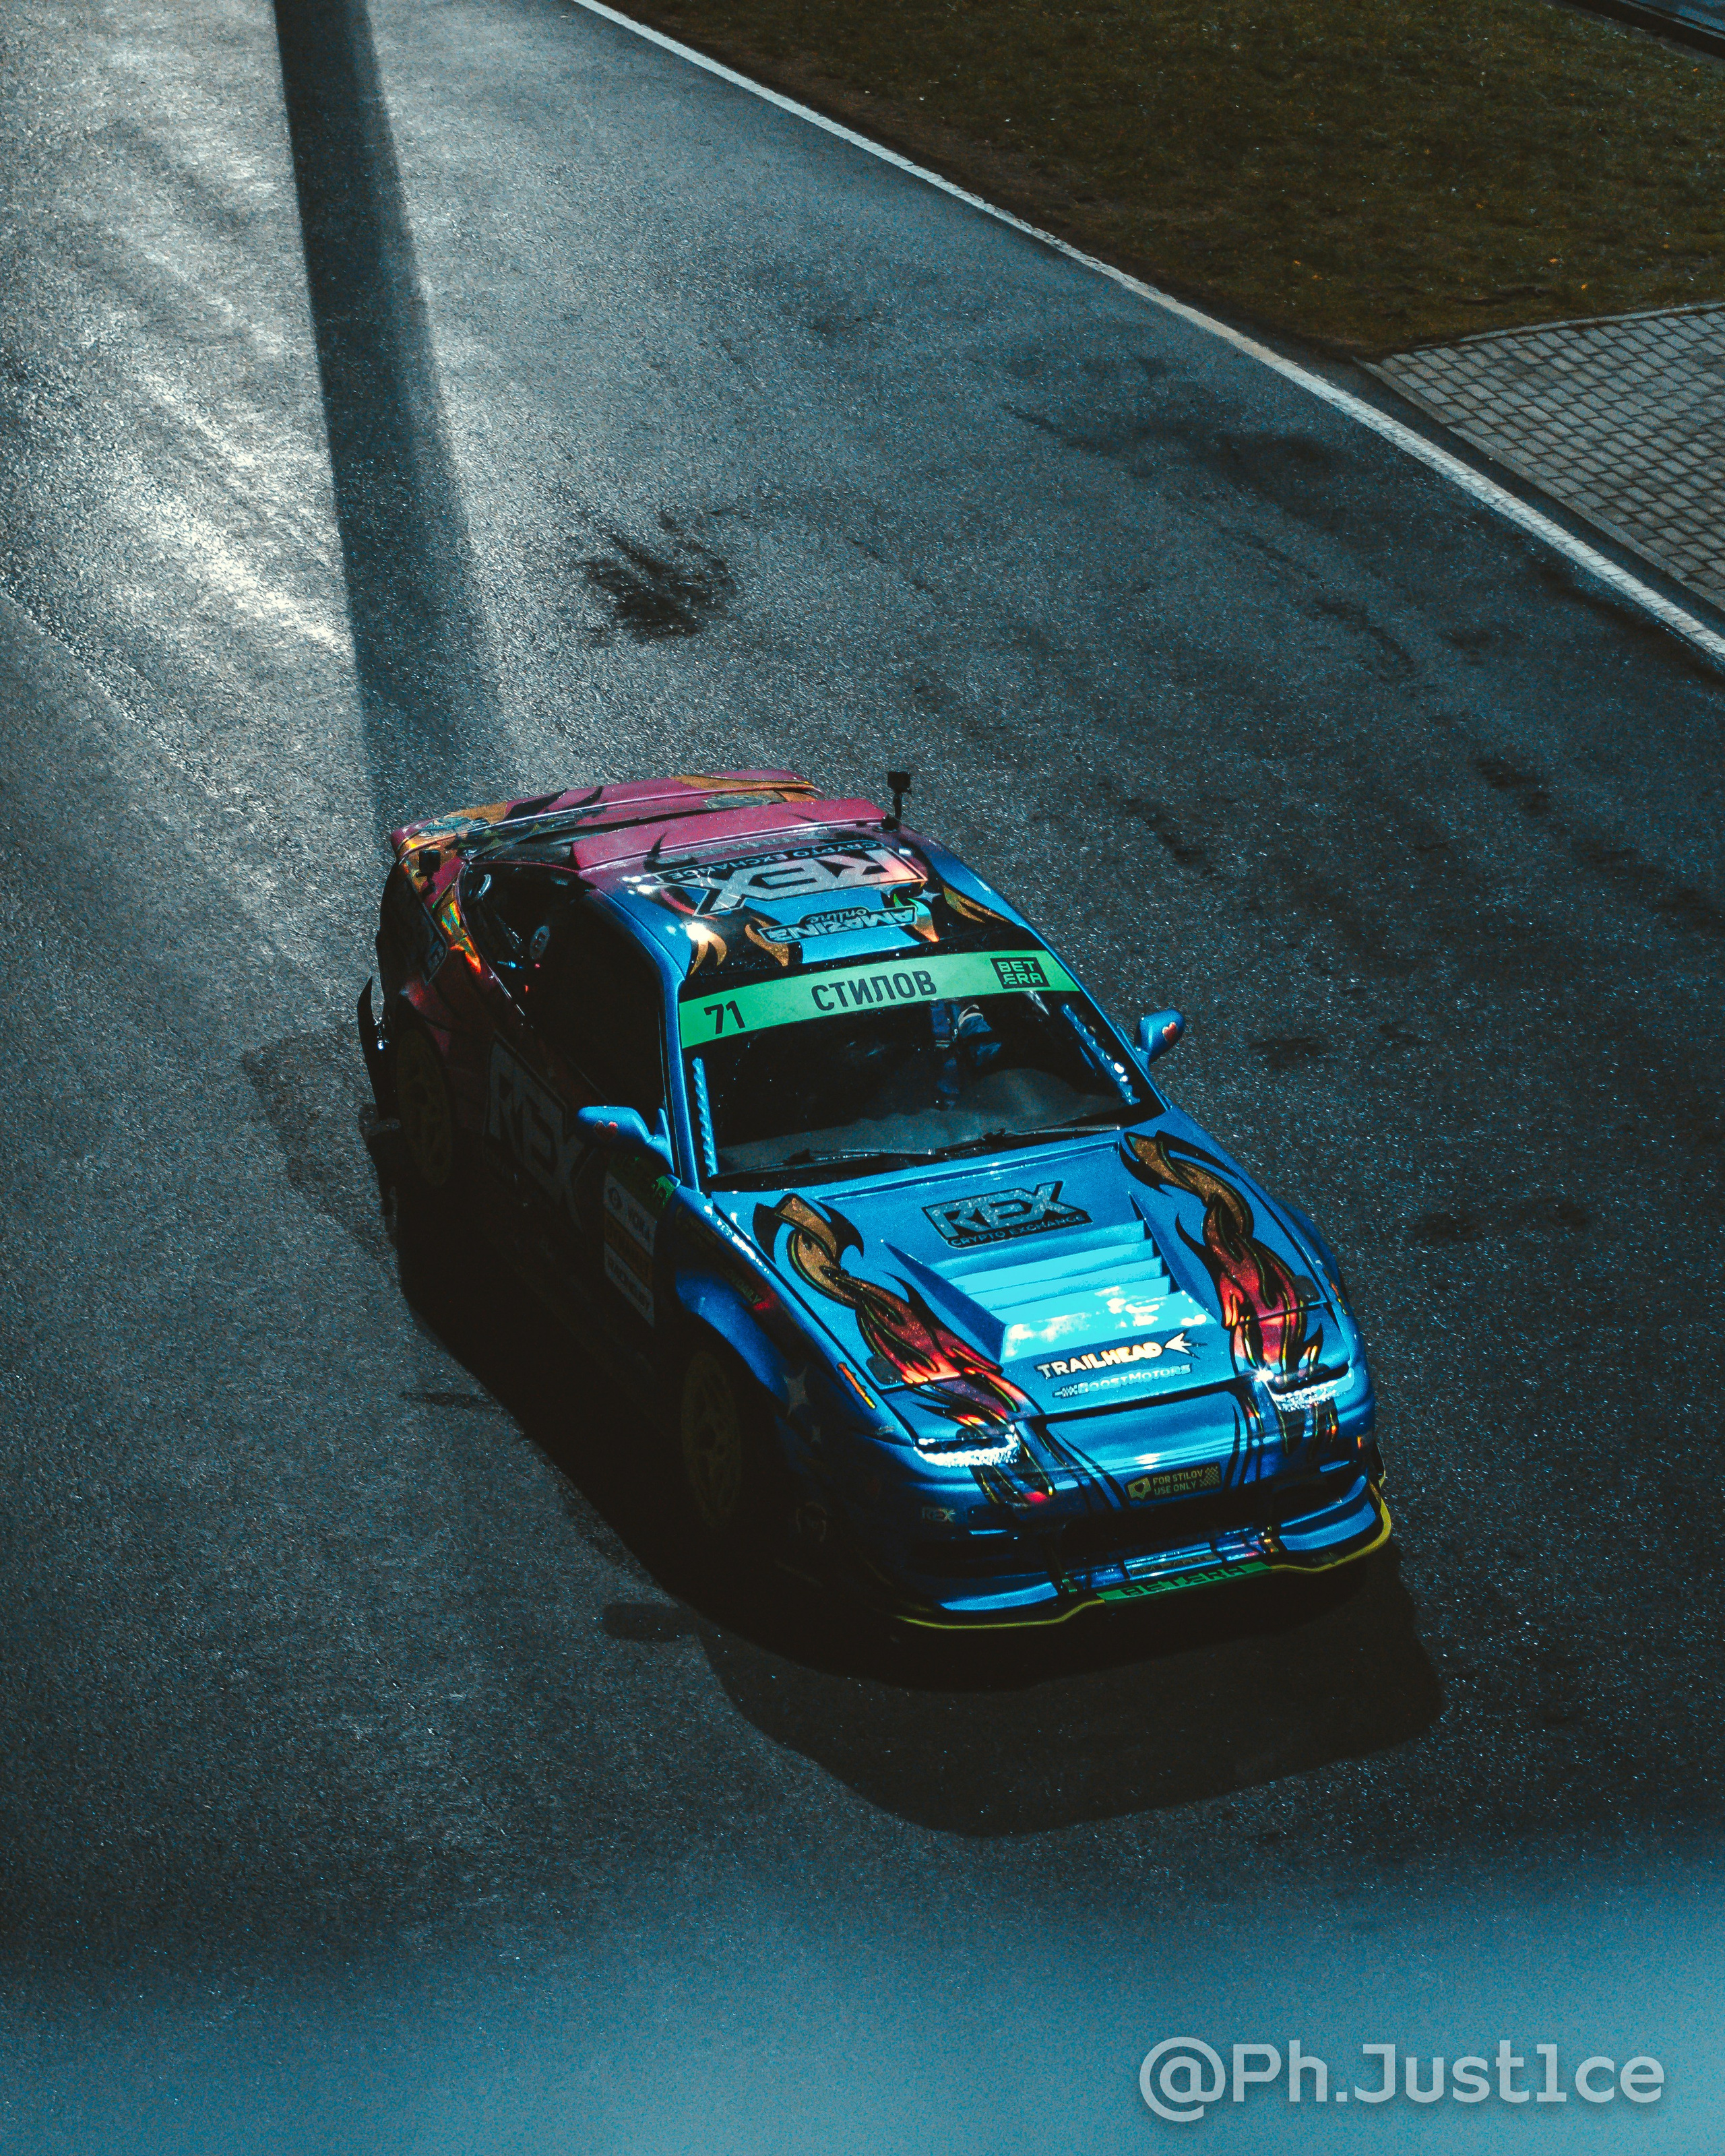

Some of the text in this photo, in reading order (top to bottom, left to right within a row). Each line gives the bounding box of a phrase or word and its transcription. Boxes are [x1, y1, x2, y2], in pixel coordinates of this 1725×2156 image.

[792, 842, 878, 858] CRYPTO
[668, 854, 788, 880] EXCHANGE
[678, 848, 918, 911] REX
[806, 909, 867, 924] online
[997, 961, 1034, 973] BET
[1003, 972, 1044, 985] ERA
[812, 970, 937, 1011] СТИЛОВ
[703, 1001, 745, 1036] 71
[925, 1182, 1079, 1238] REX
[951, 1214, 1086, 1246] CRYPTO EXCHANGE
[1037, 1341, 1163, 1380] TRAILHEAD
[1153, 1469, 1203, 1486] FOR STILOV
[1154, 1480, 1197, 1496] USE ONLY
